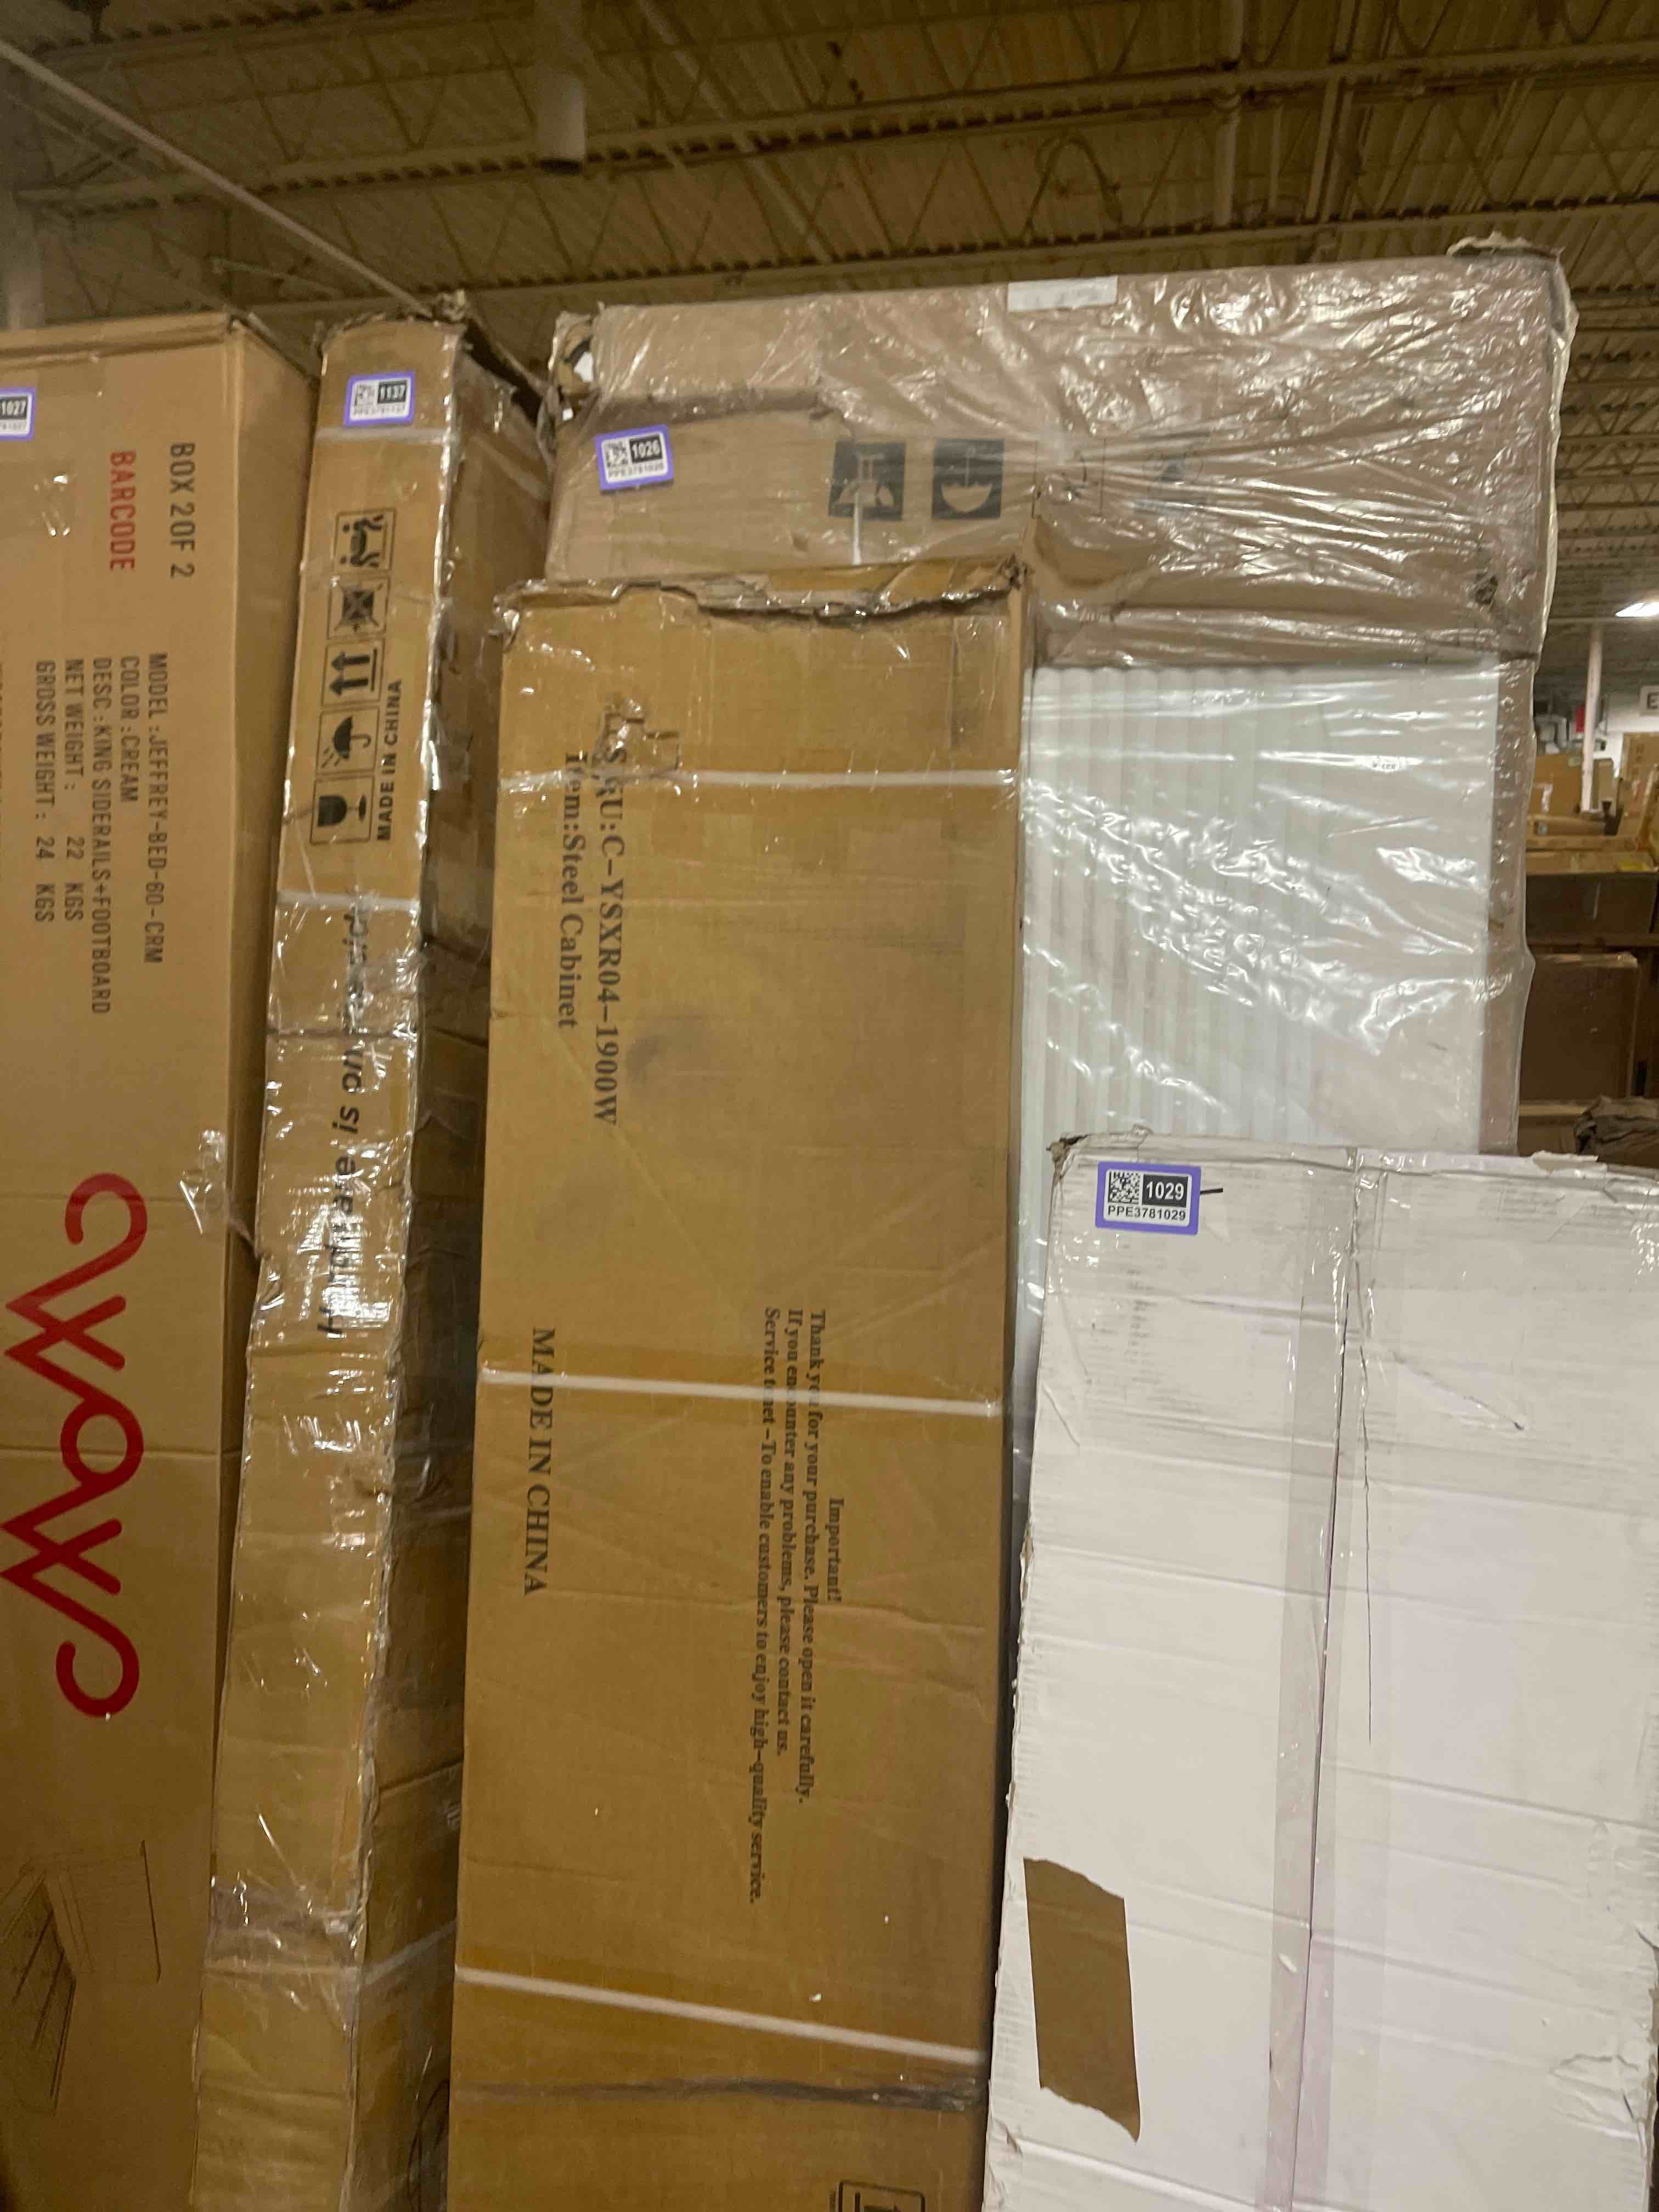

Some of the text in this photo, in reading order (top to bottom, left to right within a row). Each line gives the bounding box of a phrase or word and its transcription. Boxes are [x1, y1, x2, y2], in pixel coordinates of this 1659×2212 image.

[170, 442, 196, 494] BOX
[110, 451, 137, 571] BARCODE
[36, 661, 56, 726] GROSS
[65, 658, 84, 696] NET
[377, 680, 402, 841] MADE IN CHINA
[35, 836, 55, 860] 24
[66, 836, 86, 860] 22
[34, 883, 55, 922] KGS
[64, 882, 84, 922] KGS
[558, 911, 584, 1029] Cabinet
[342, 1049, 363, 1092] on
[332, 1105, 360, 1135] is
[1108, 1205, 1186, 1221] PPE3781029
[1146, 1181, 1184, 1201] 1029
[764, 1306, 780, 1374] Service
[788, 1309, 803, 1326] If
[785, 1328, 799, 1361] you
[763, 1379, 776, 1423] tnet
[523, 1328, 555, 1596] MADE IN CHINA
[761, 1440, 776, 1464] To
[759, 1469, 775, 1529] enable
[780, 1462, 795, 1493] any
[780, 1496, 797, 1591] problems,
[795, 1309, 826, 1804] Thank yo for your purchase. Please open it carefully.
[825, 1497, 844, 1602] Important!
[757, 1534, 770, 1627] customers
[757, 1631, 768, 1649] to
[777, 1595, 794, 1653] please
[751, 1654, 769, 1703] enjoy
[777, 1658, 791, 1725] contact
[777, 1730, 788, 1756] us.
[750, 1832, 766, 1904] service.
